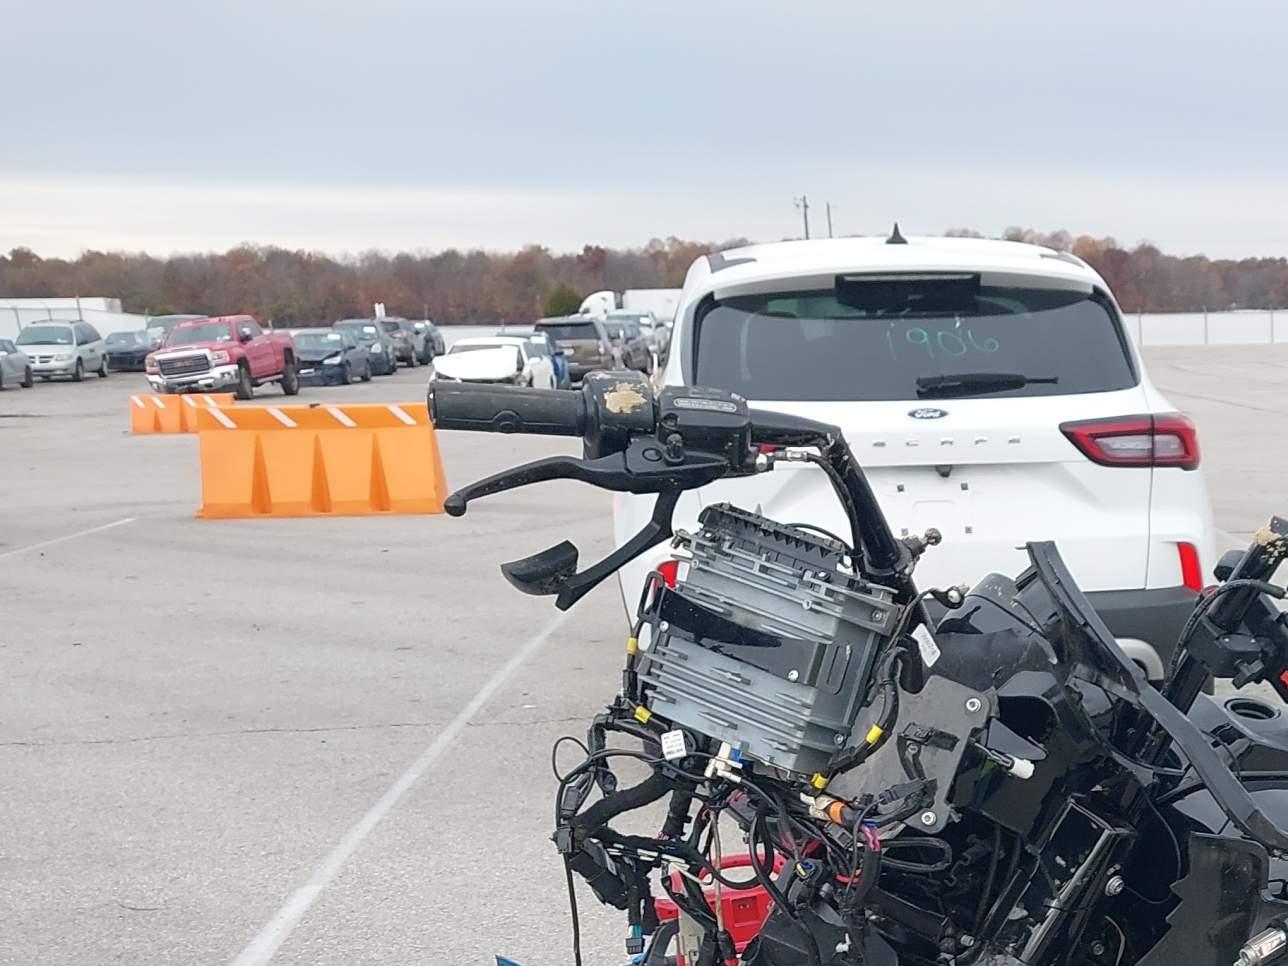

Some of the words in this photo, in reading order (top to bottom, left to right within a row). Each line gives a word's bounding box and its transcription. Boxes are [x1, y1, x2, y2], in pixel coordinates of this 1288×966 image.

[886, 326, 1000, 360] 1906
[913, 408, 943, 419] Ford
[848, 436, 1021, 447] SCAPE
